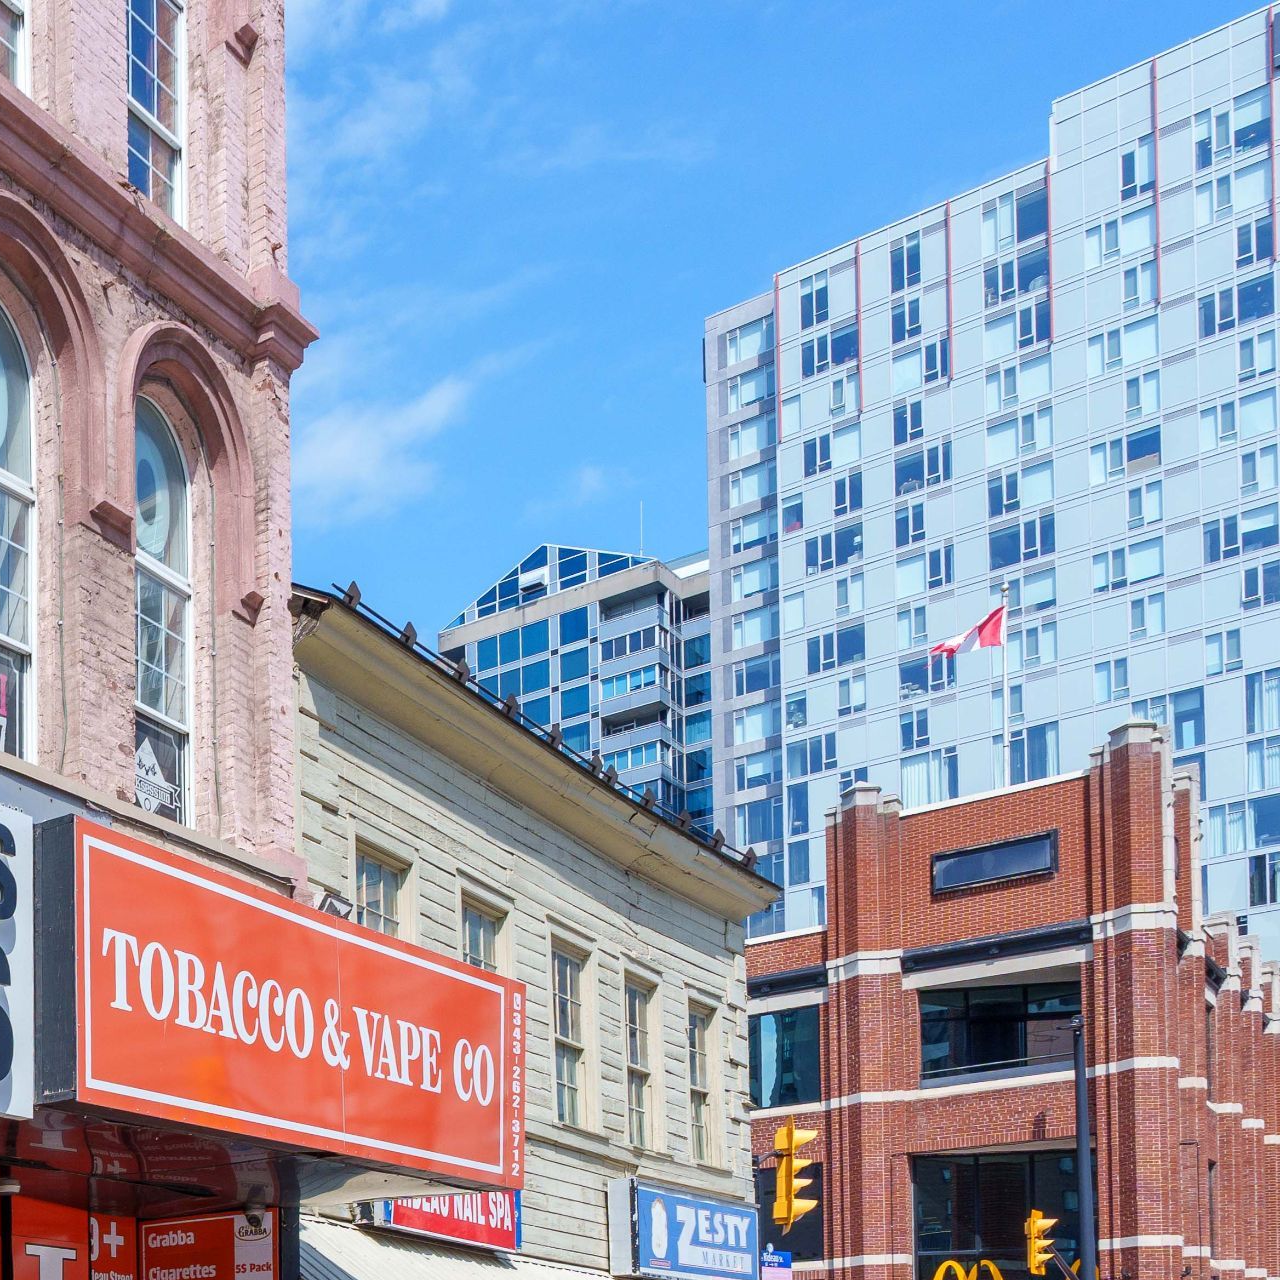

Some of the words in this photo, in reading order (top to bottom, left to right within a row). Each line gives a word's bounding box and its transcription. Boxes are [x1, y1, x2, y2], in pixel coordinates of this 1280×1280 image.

[101, 927, 315, 1059] TOBACCO
[321, 998, 351, 1071] &
[351, 1005, 443, 1094] VAPE
[453, 1038, 496, 1107] CO
[511, 1012, 522, 1177] 343-262-3712
[453, 1192, 486, 1225] NAIL
[488, 1191, 513, 1231] SPA
[148, 1230, 195, 1249] Grabba
[676, 1205, 751, 1266] ZESTY
[249, 1262, 272, 1273] Pack
[702, 1251, 745, 1270] MARKET
